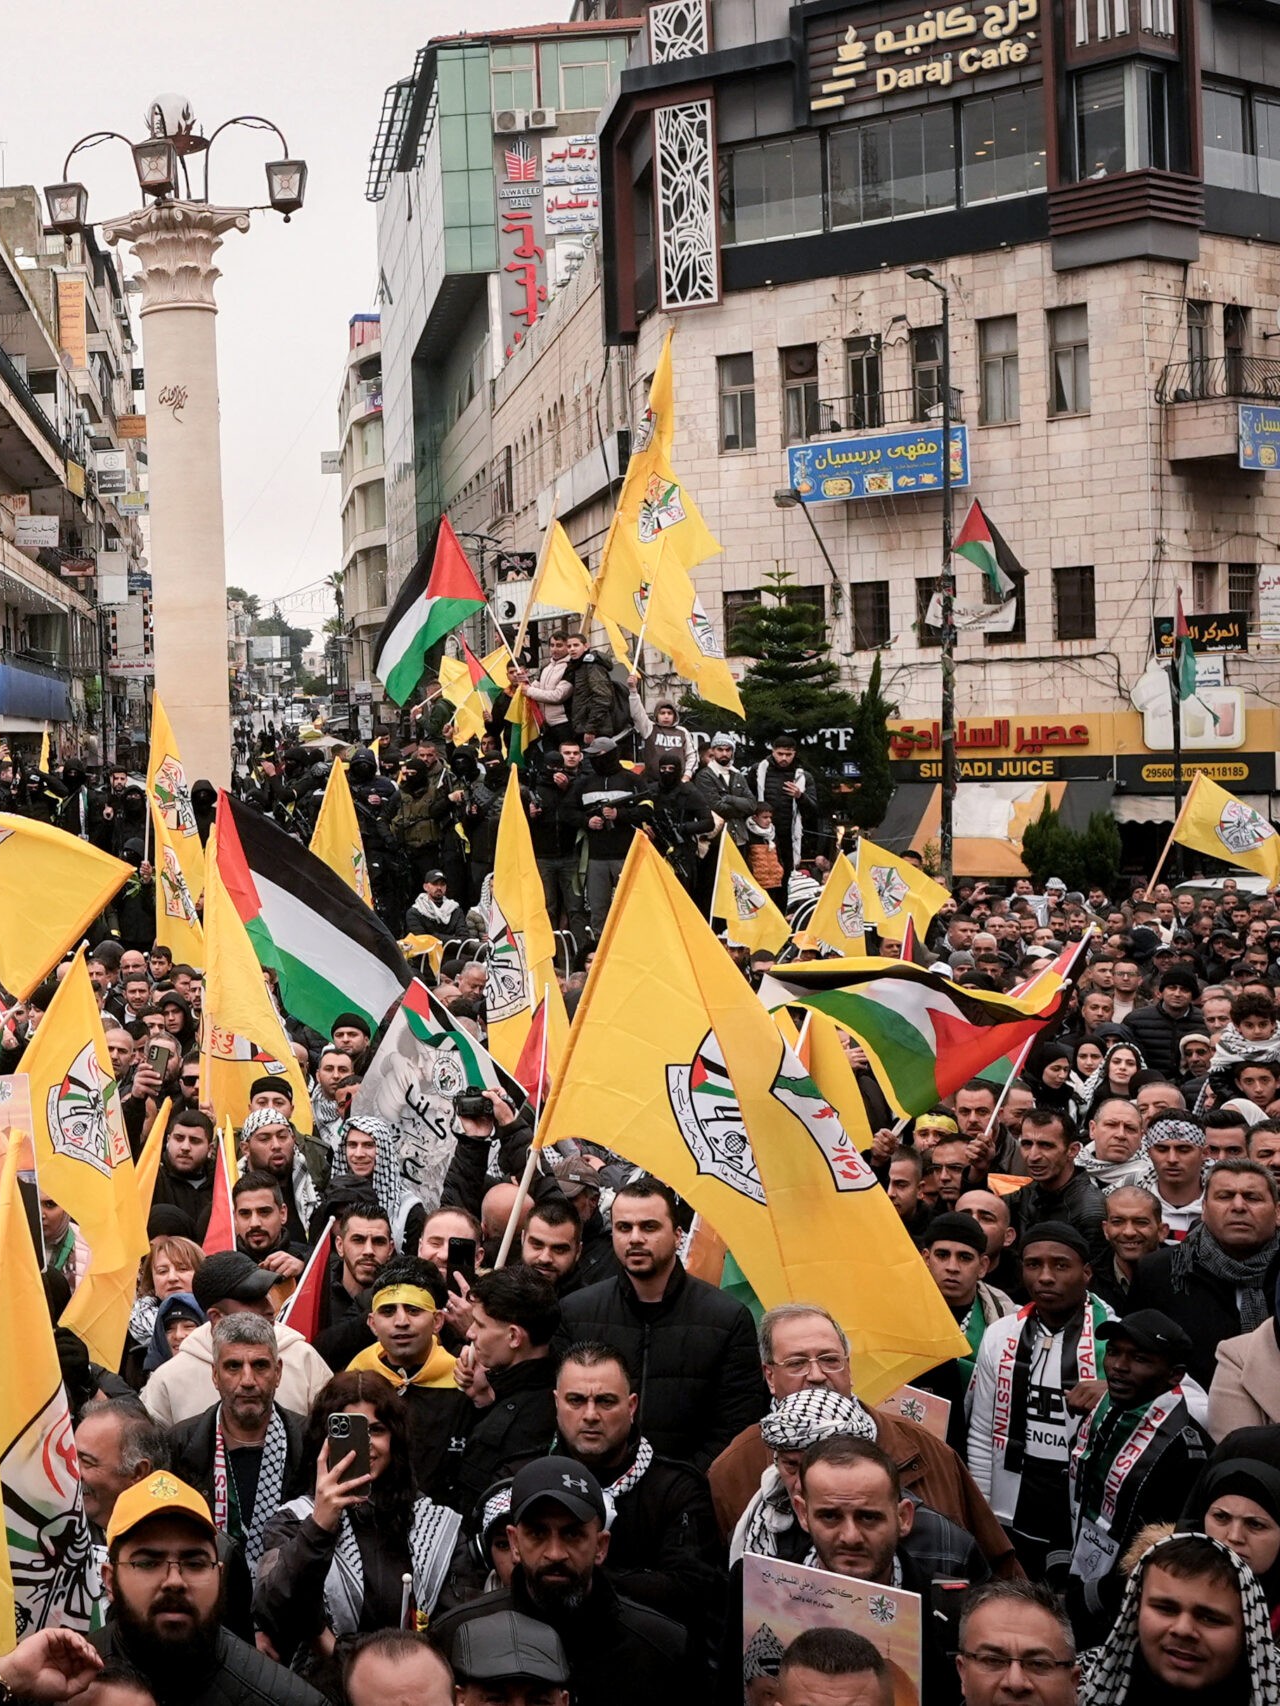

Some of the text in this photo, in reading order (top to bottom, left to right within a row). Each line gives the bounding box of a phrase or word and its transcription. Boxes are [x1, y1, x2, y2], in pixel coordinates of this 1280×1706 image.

[874, 0, 1037, 55] درج كافيه
[876, 52, 952, 93] Daraj
[501, 187, 541, 197] ALWALEED
[510, 199, 532, 208] MALL
[887, 438, 938, 461] مقهى
[1201, 621, 1240, 643] المركز
[655, 733, 683, 748] NIKE
[1014, 724, 1090, 754] عصير
[997, 760, 1054, 776] JUICE
[991, 1337, 1017, 1451] PALESTINE
[1102, 1406, 1167, 1517] PALESTINE
[1083, 1528, 1115, 1558] فلسطين
